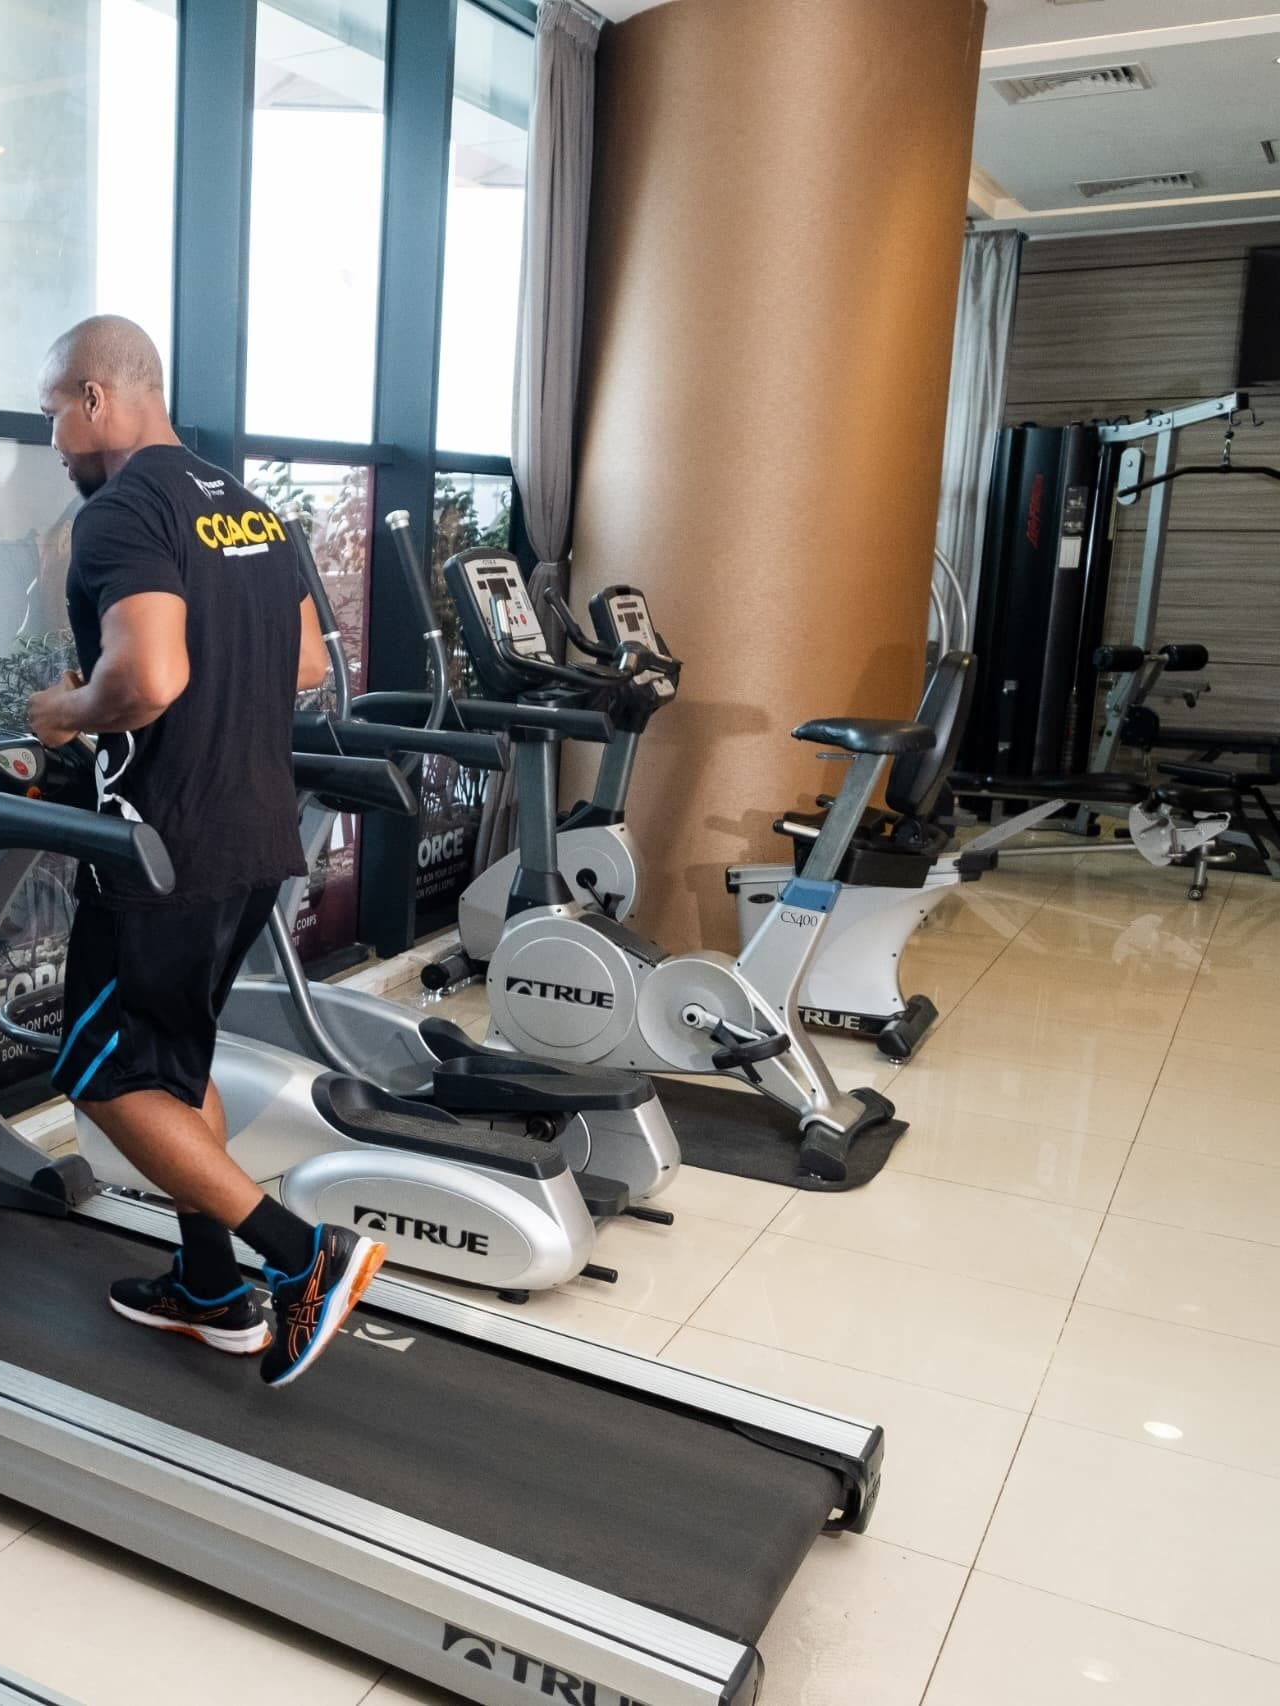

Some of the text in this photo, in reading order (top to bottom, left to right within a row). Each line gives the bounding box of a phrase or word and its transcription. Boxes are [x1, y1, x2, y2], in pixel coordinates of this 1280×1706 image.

[195, 510, 287, 549] COACH
[417, 826, 464, 868] ORCE
[780, 910, 818, 928] CS400
[533, 980, 614, 1010] TRUE
[43, 1009, 63, 1028] POU
[2, 1042, 23, 1062] BON
[388, 1212, 489, 1256] TRUE
